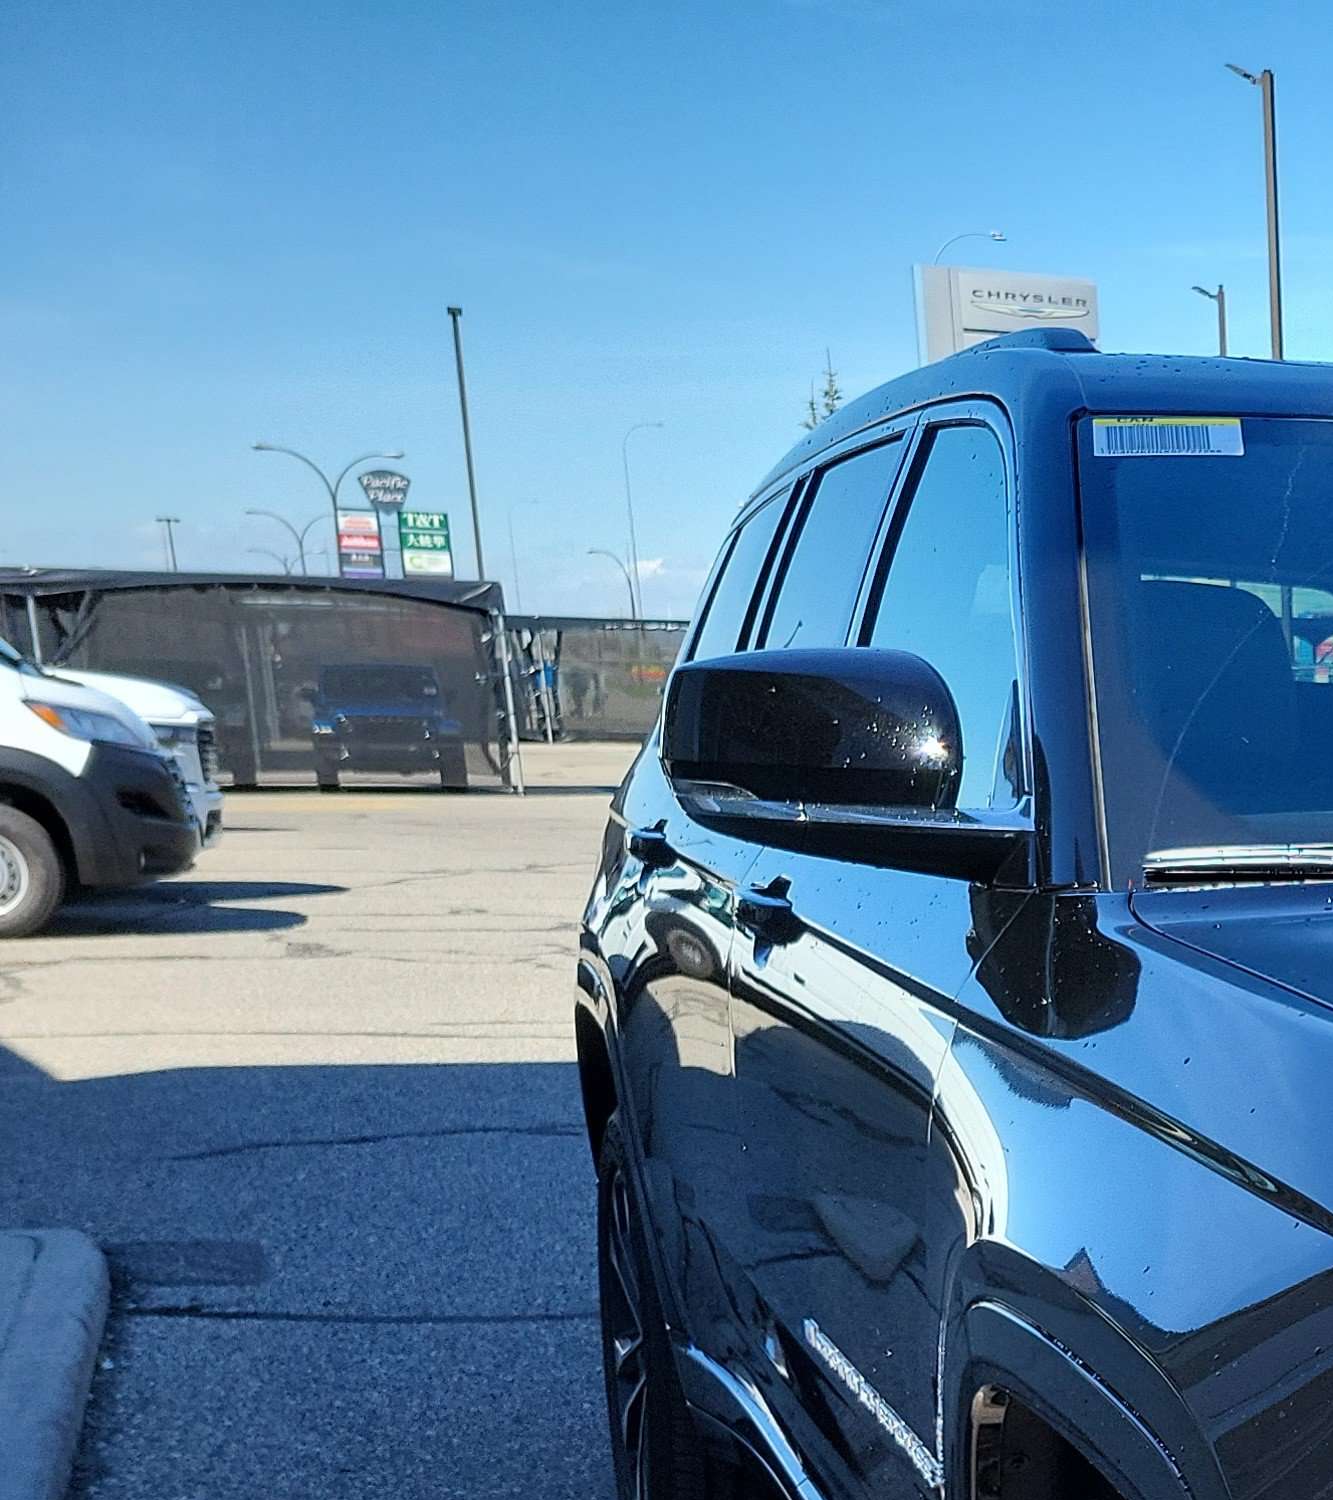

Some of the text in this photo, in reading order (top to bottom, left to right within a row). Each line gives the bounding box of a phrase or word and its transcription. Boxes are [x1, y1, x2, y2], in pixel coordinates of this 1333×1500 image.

[971, 288, 1088, 307] CHRYSLER
[362, 475, 408, 489] Pacific
[402, 512, 444, 529] T&T
